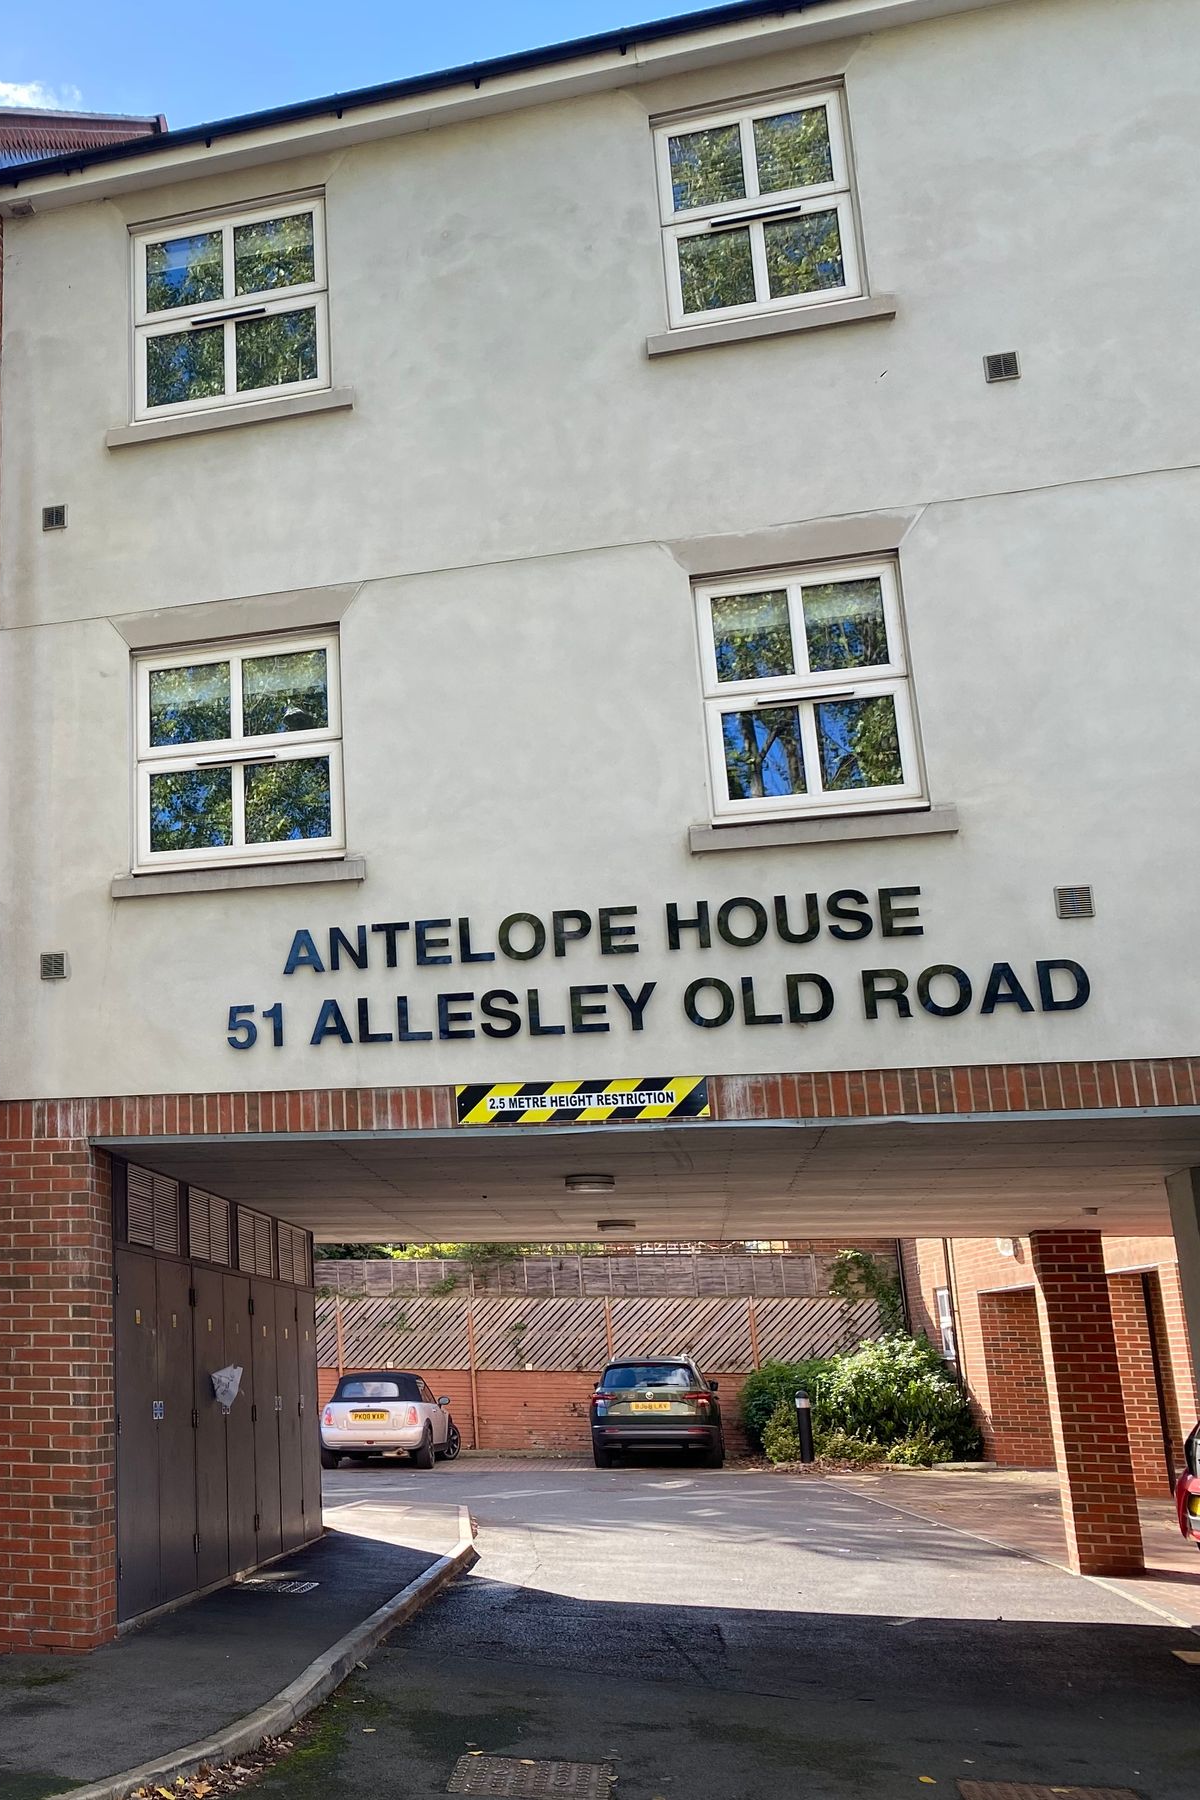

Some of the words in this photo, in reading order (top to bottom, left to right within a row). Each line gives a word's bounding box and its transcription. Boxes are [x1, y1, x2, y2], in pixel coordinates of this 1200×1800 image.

[283, 905, 640, 975] ANTELOPE
[665, 885, 924, 951] HOUSE
[227, 1002, 284, 1050] 51
[310, 982, 658, 1046] ALLESLEY
[683, 972, 835, 1028] OLD
[861, 957, 1091, 1020] ROAD
[489, 1097, 506, 1110] 2.5
[508, 1096, 547, 1110] METRE
[550, 1094, 593, 1108] HEIGHT
[597, 1091, 674, 1106] RESTRICTION
